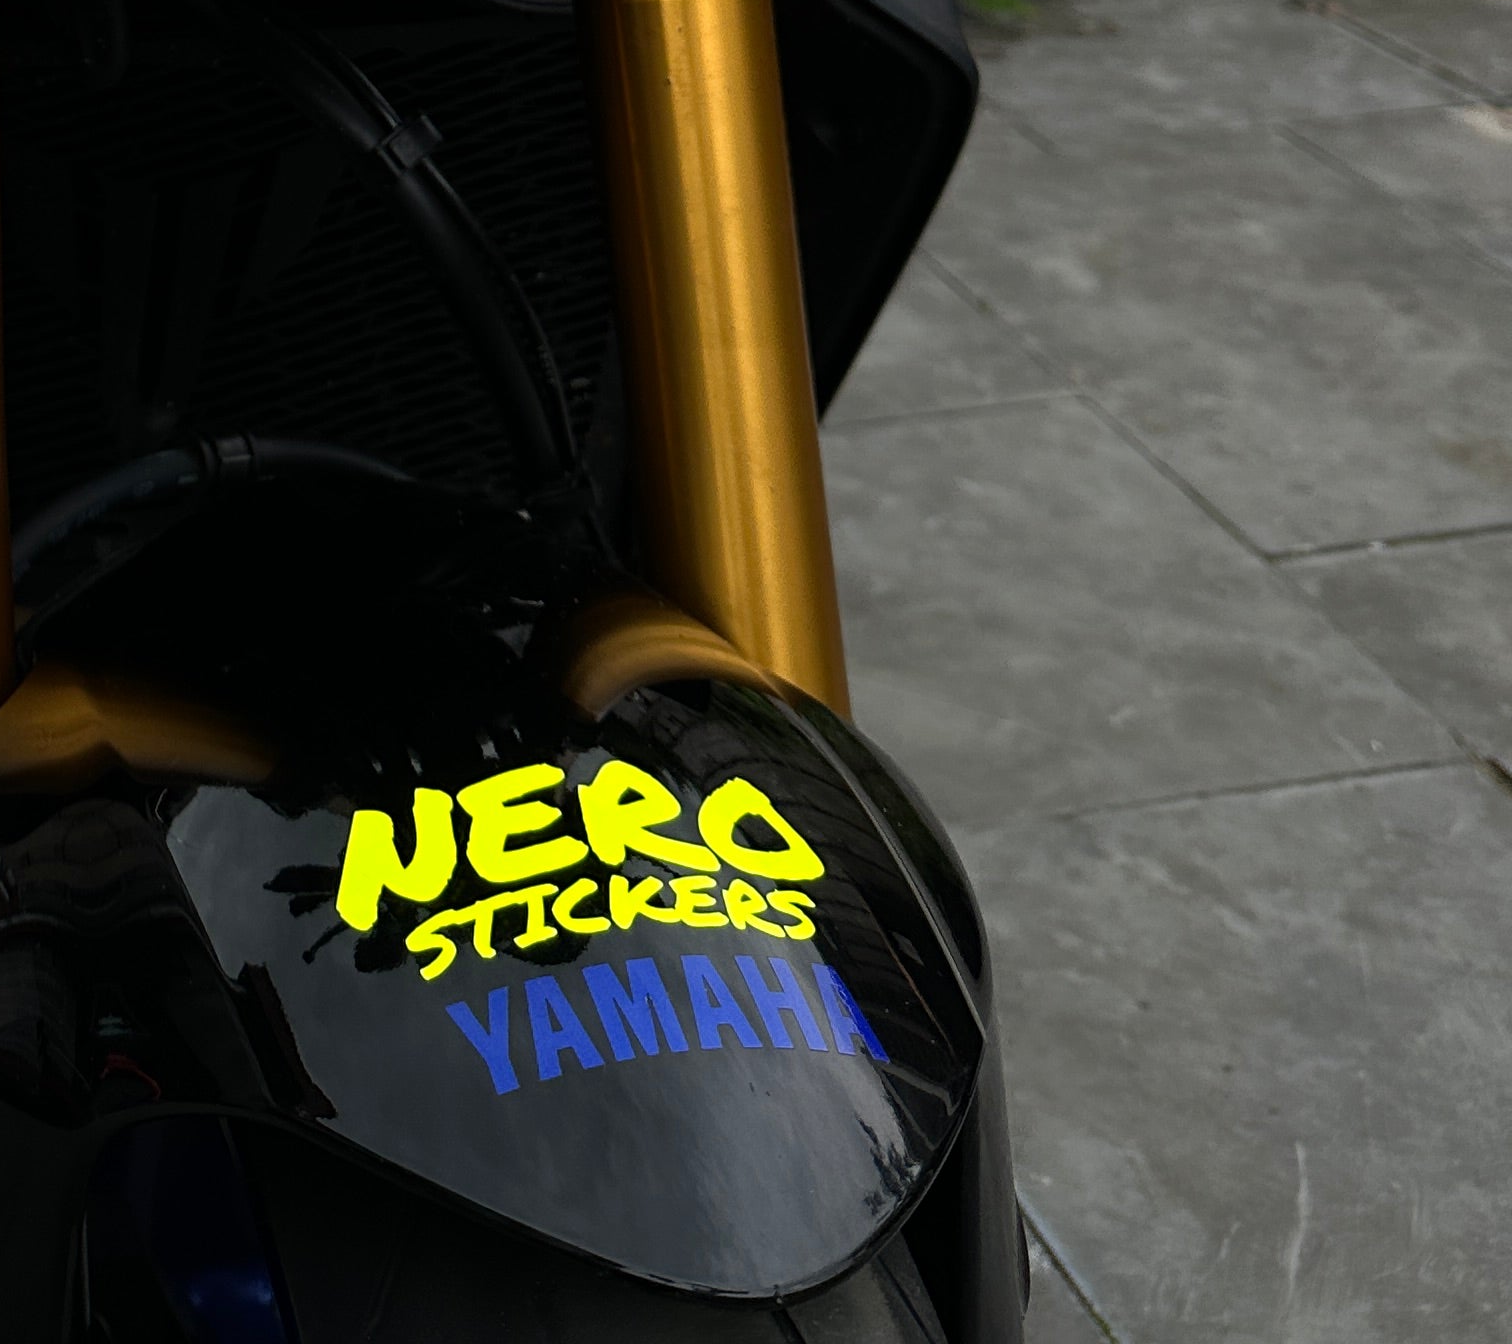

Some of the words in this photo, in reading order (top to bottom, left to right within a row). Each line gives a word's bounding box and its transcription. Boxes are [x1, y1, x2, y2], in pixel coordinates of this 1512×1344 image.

[335, 760, 825, 932] NERO
[405, 874, 816, 981] STICKERS
[445, 954, 890, 1096] YAMAHA
